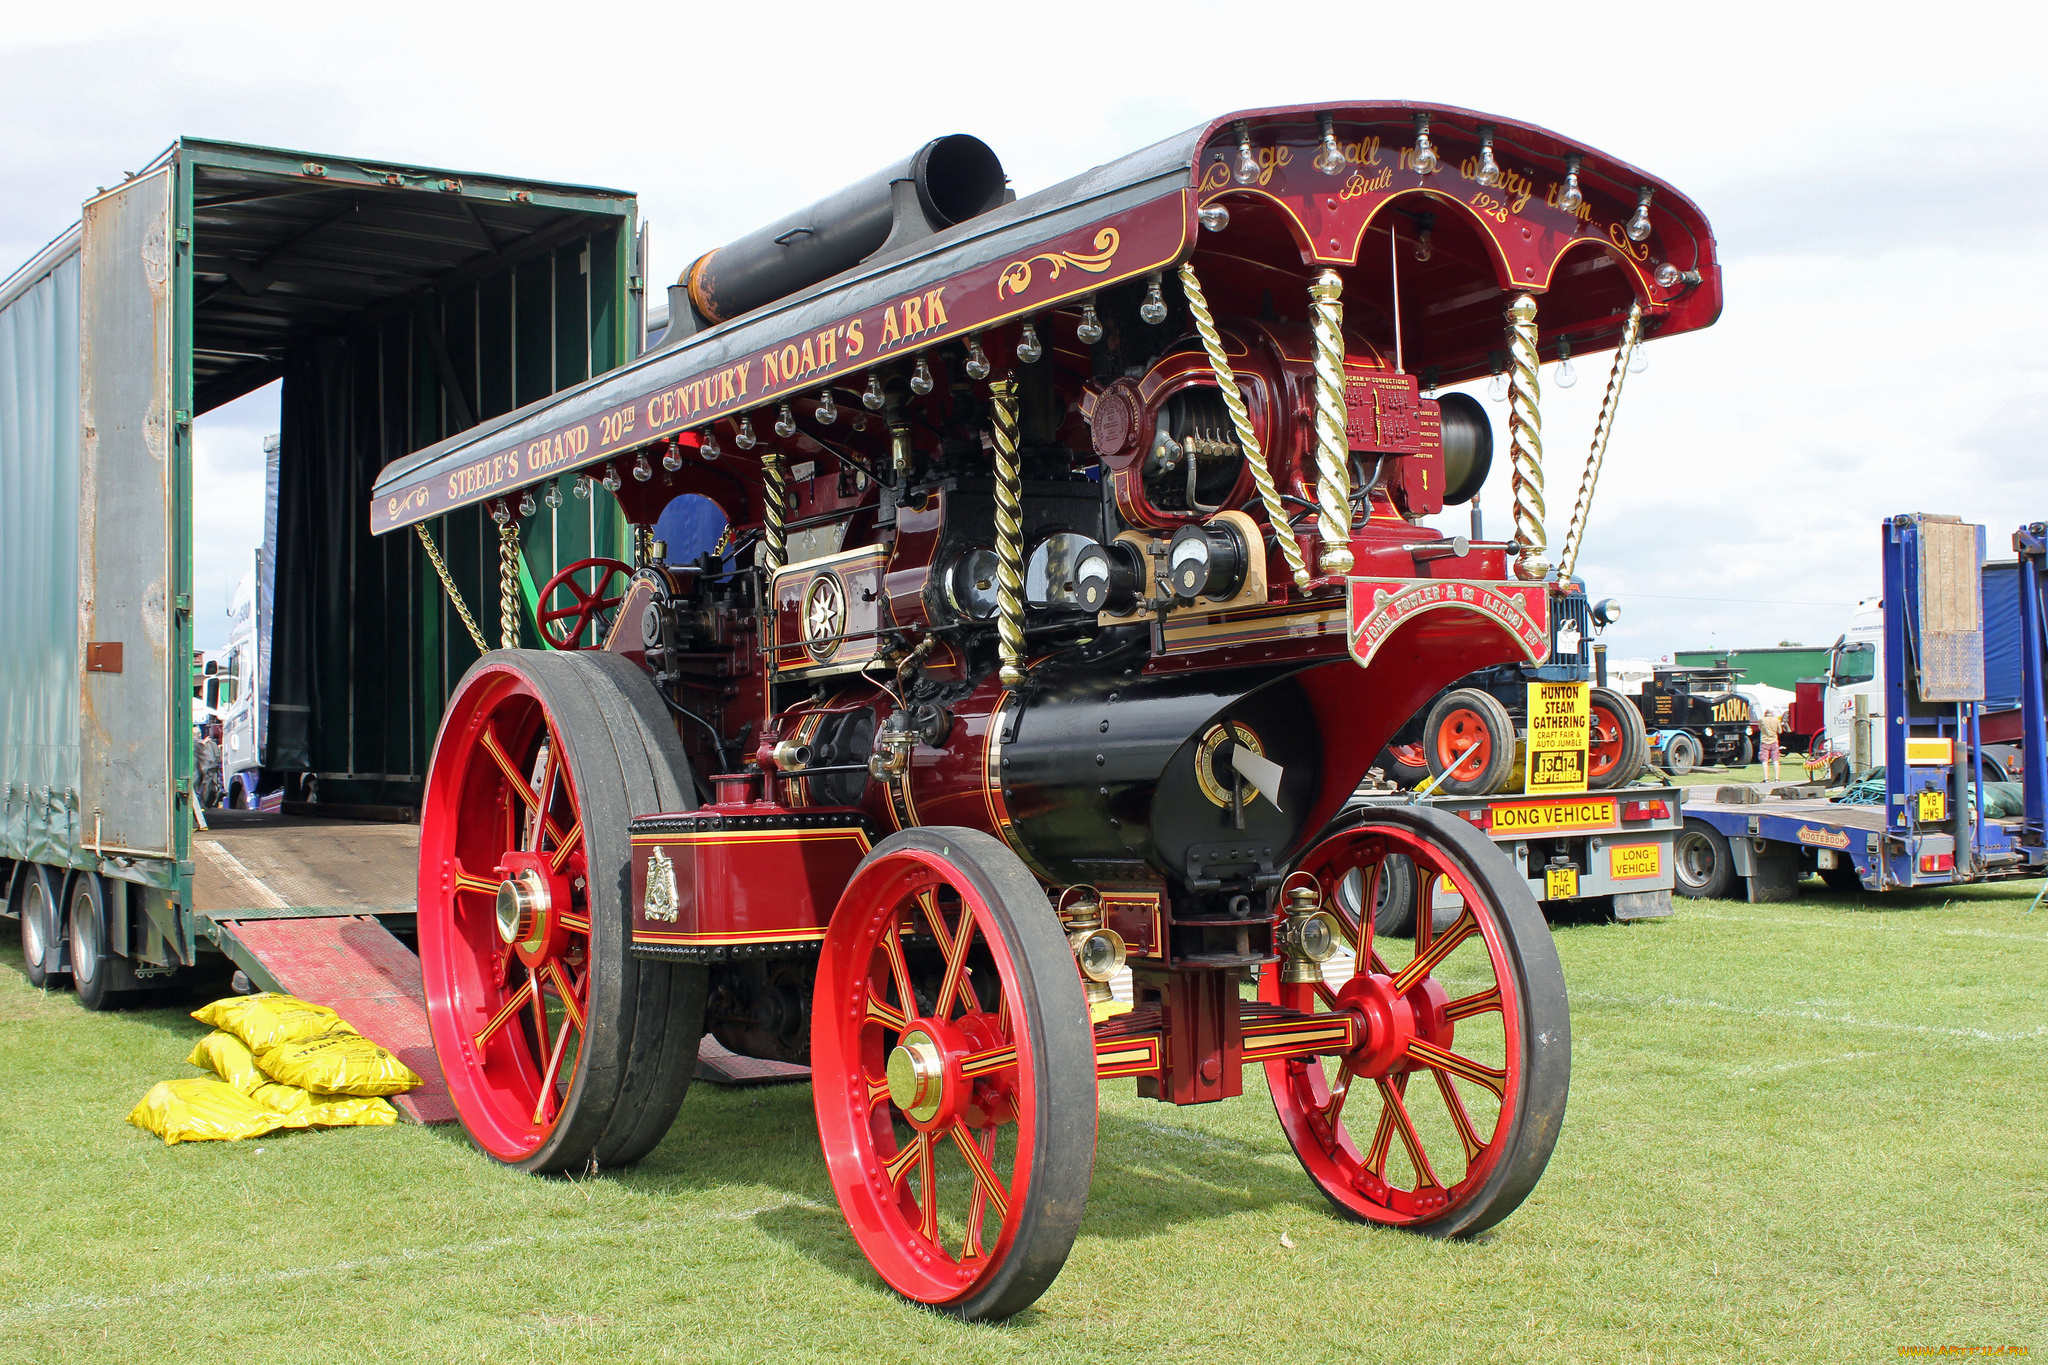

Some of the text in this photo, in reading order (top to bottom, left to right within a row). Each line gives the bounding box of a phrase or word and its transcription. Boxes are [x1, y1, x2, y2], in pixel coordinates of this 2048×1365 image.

[1312, 136, 1382, 169] Sall
[1460, 155, 1532, 214] wary
[1340, 166, 1509, 223] Built 1928
[448, 286, 949, 500] STEELE'S GRAND 20TH CENTURY NOAH'S ARK
[1365, 611, 1391, 647] JOHN
[1394, 586, 1441, 616] FOWLER
[1540, 686, 1579, 700] HUNTON
[1544, 701, 1575, 715] STEAM
[1533, 715, 1585, 730] GATHERING
[1236, 729, 1252, 743] WLER
[1537, 731, 1558, 739] CRAFT
[1560, 731, 1575, 739] FAIR
[1536, 739, 1583, 748] AUTO JUMBLE
[1541, 757, 1575, 772] 13 & 14
[1533, 769, 1582, 783] SEPTEMBER
[1925, 795, 1937, 806] V8
[1495, 804, 1610, 826] LONG VEHICLE
[1923, 808, 1940, 819] HWS
[1801, 831, 1845, 845] NOOTEBOOM
[1623, 849, 1649, 860] LONG
[1615, 862, 1656, 874] VEHICLE
[1553, 870, 1569, 882] F12
[1552, 884, 1572, 897] DHC
